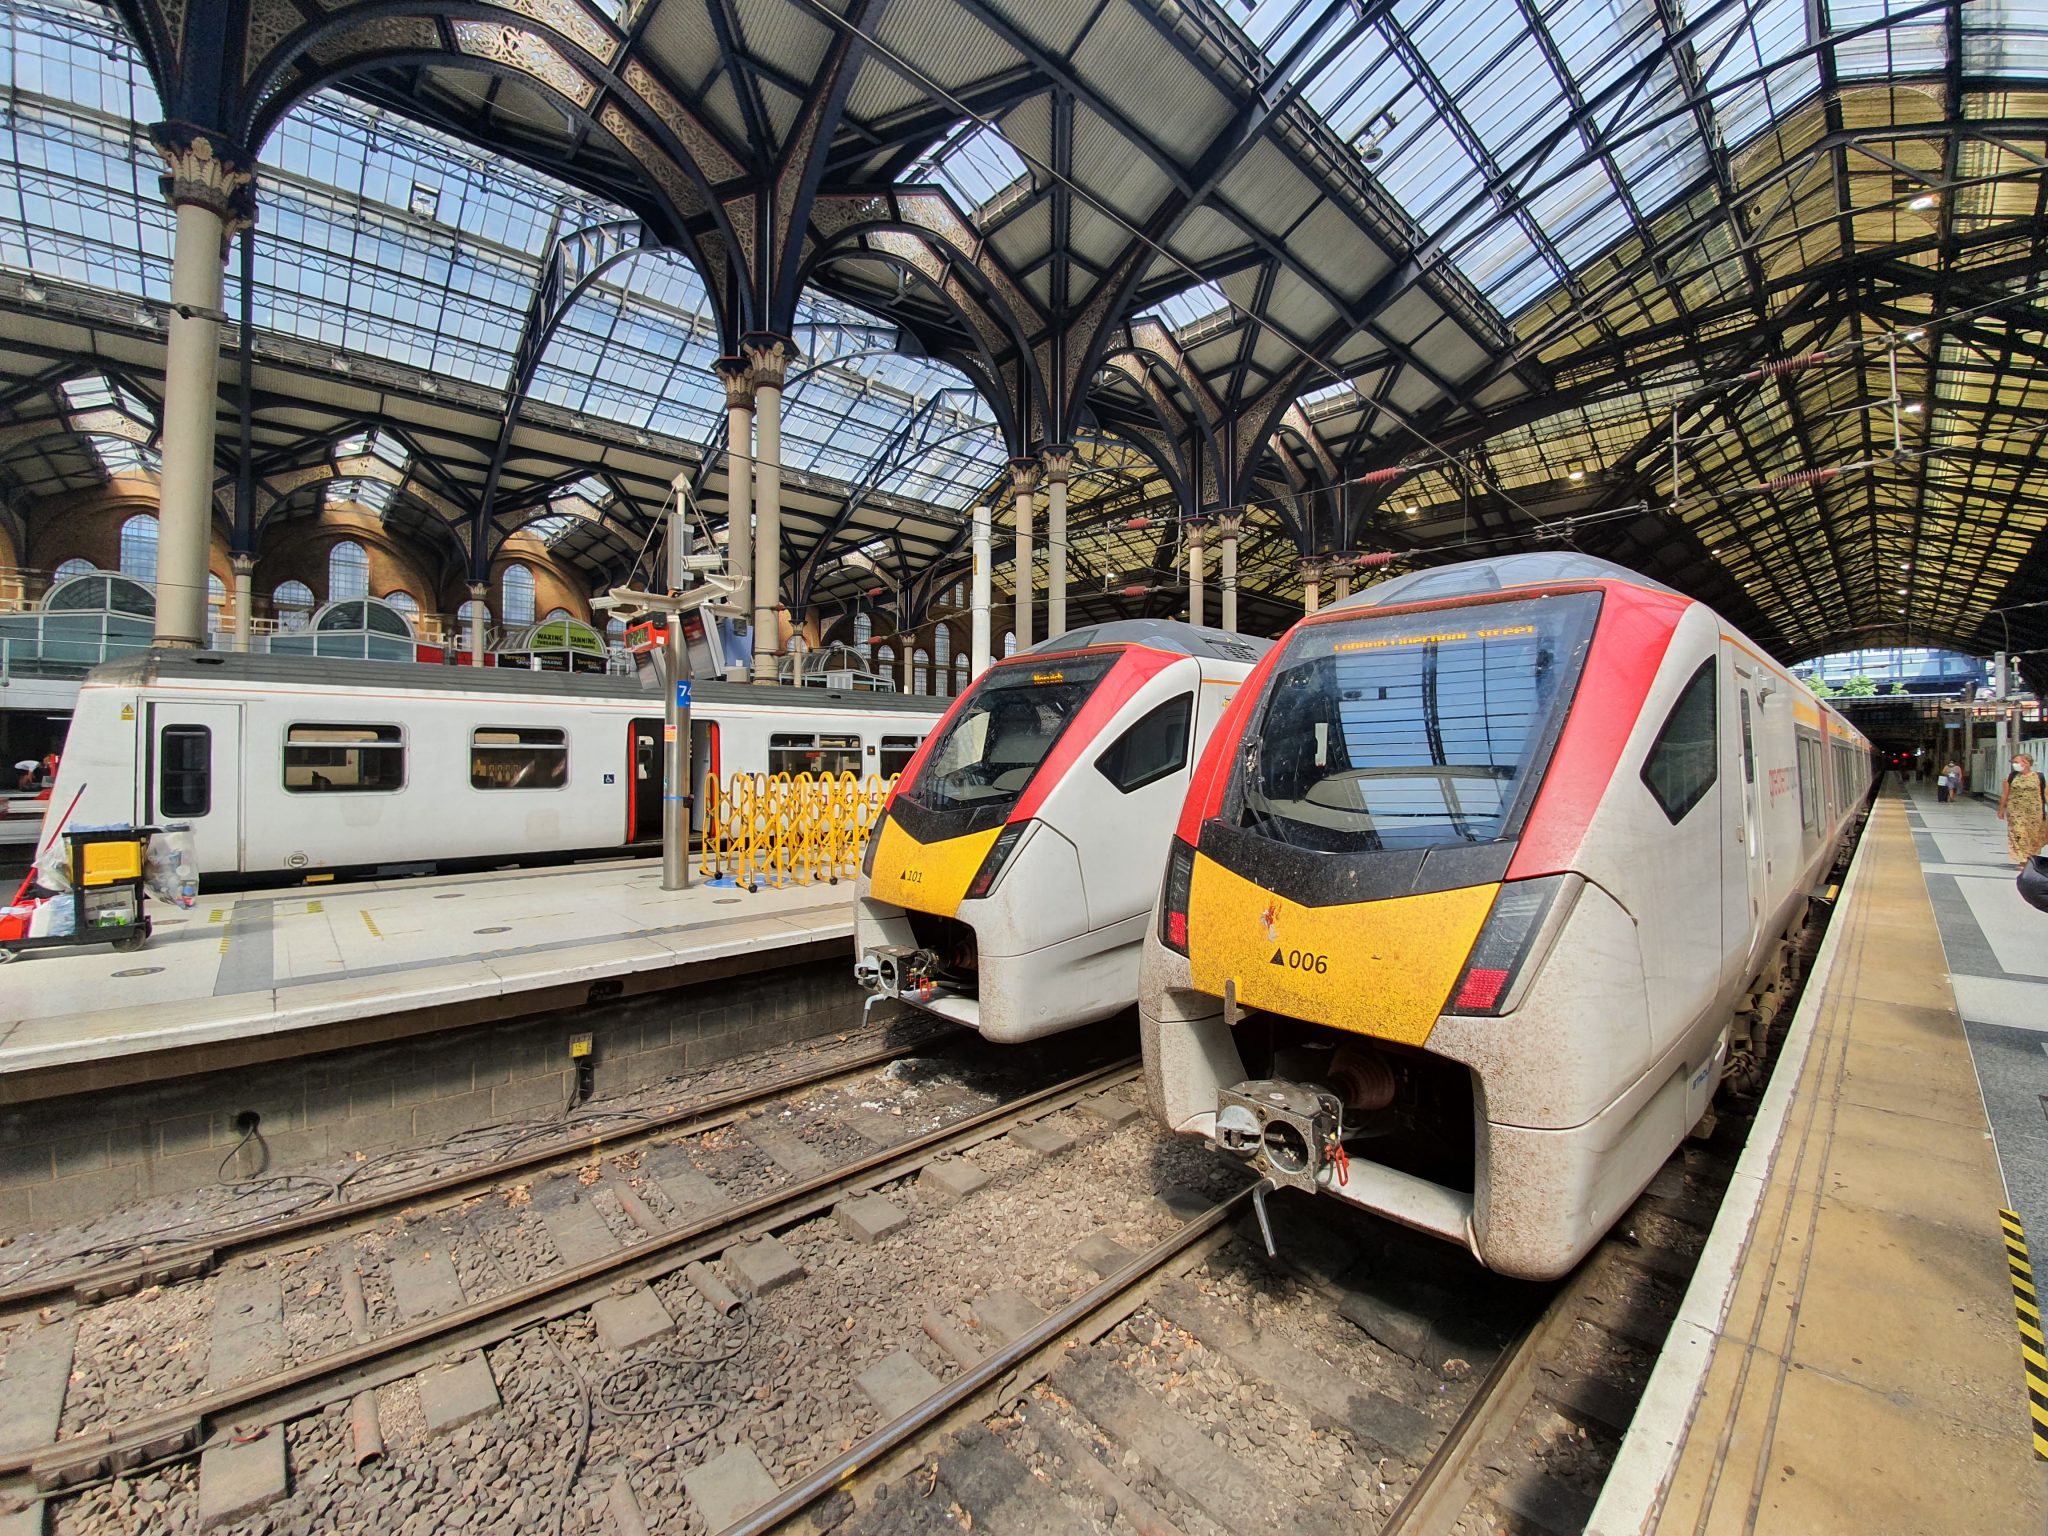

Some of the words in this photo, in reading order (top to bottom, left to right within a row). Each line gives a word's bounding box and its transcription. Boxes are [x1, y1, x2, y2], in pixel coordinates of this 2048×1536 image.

[537, 633, 563, 641] WAXING
[570, 635, 596, 645] TANNING
[1033, 673, 1063, 684] Norwich
[907, 870, 922, 883] 101
[1289, 949, 1328, 974] 006
